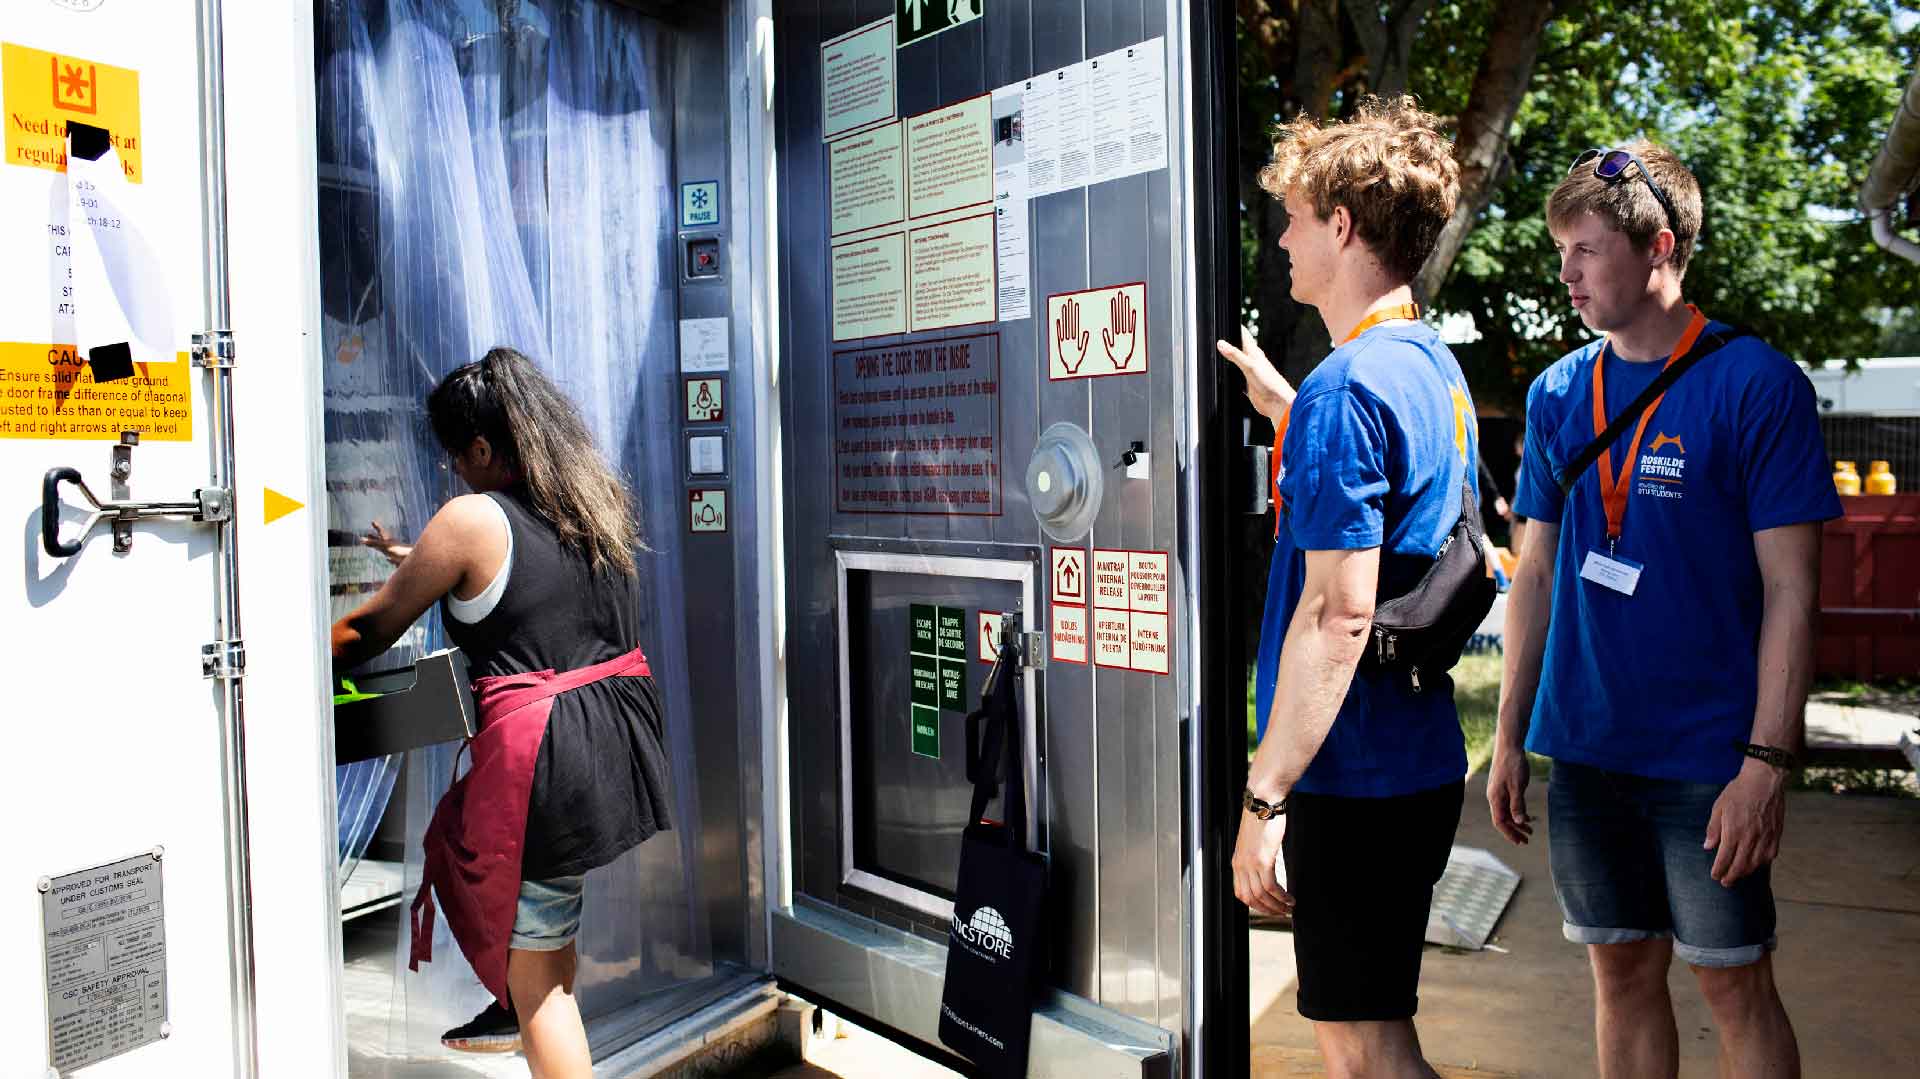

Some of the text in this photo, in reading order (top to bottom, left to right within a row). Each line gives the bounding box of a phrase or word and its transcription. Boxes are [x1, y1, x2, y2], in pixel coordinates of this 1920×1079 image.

[13, 112, 49, 135] Need
[54, 123, 67, 137] to
[124, 136, 136, 149] at
[690, 211, 711, 221] PAUSE
[48, 350, 83, 366] CAU
[882, 352, 893, 376] THE
[896, 350, 912, 376] DOOR
[915, 347, 932, 375] FROM
[935, 345, 946, 372] THE
[950, 343, 970, 369] INSIDE
[0, 368, 40, 382] Ensure
[45, 371, 72, 382] solid
[74, 371, 92, 383] flat
[131, 376, 168, 388] ground
[8, 387, 34, 398] door
[38, 387, 70, 399] frame
[74, 388, 128, 401] difference
[131, 389, 142, 400] of
[144, 389, 186, 404] diagonal
[38, 404, 48, 415] to
[52, 403, 75, 416] less
[78, 404, 101, 416] than
[105, 408, 117, 416] or
[119, 406, 147, 419] equal
[151, 407, 160, 417] to
[163, 406, 187, 420] keep
[0, 420, 11, 432] ft
[15, 420, 36, 432] and
[40, 420, 67, 435] right
[70, 424, 107, 432] arrows
[111, 422, 120, 432] at
[154, 422, 177, 433] level
[1641, 455, 1685, 469] ROSKILDE
[1640, 465, 1682, 478] FESTIVAL
[1651, 490, 1682, 499] STUDENTS
[1097, 561, 1124, 572] MANTRAP
[1097, 574, 1125, 585] INTERNAL
[1099, 586, 1122, 597] RELEASE
[1144, 593, 1158, 602] PORTE
[916, 618, 932, 629] ESCAPE
[942, 616, 959, 627] TRAPPE
[1098, 621, 1125, 630] APERTURA
[917, 630, 931, 640] HATCH
[940, 627, 962, 639] DE SORTIE
[1096, 631, 1127, 643] INTERNA DE
[1137, 629, 1159, 640] INTERNE
[939, 637, 964, 650] DE SECOURS
[1102, 643, 1122, 653] PUERTA
[51, 863, 153, 896] APPROVED FOR TRANSPORT
[60, 892, 86, 905] UNDER
[89, 882, 124, 897] CUSTOMS
[127, 877, 144, 888] SEAL
[62, 988, 78, 1000] CSC
[81, 979, 109, 994] SAFETY
[112, 967, 150, 984] APPROVAL
